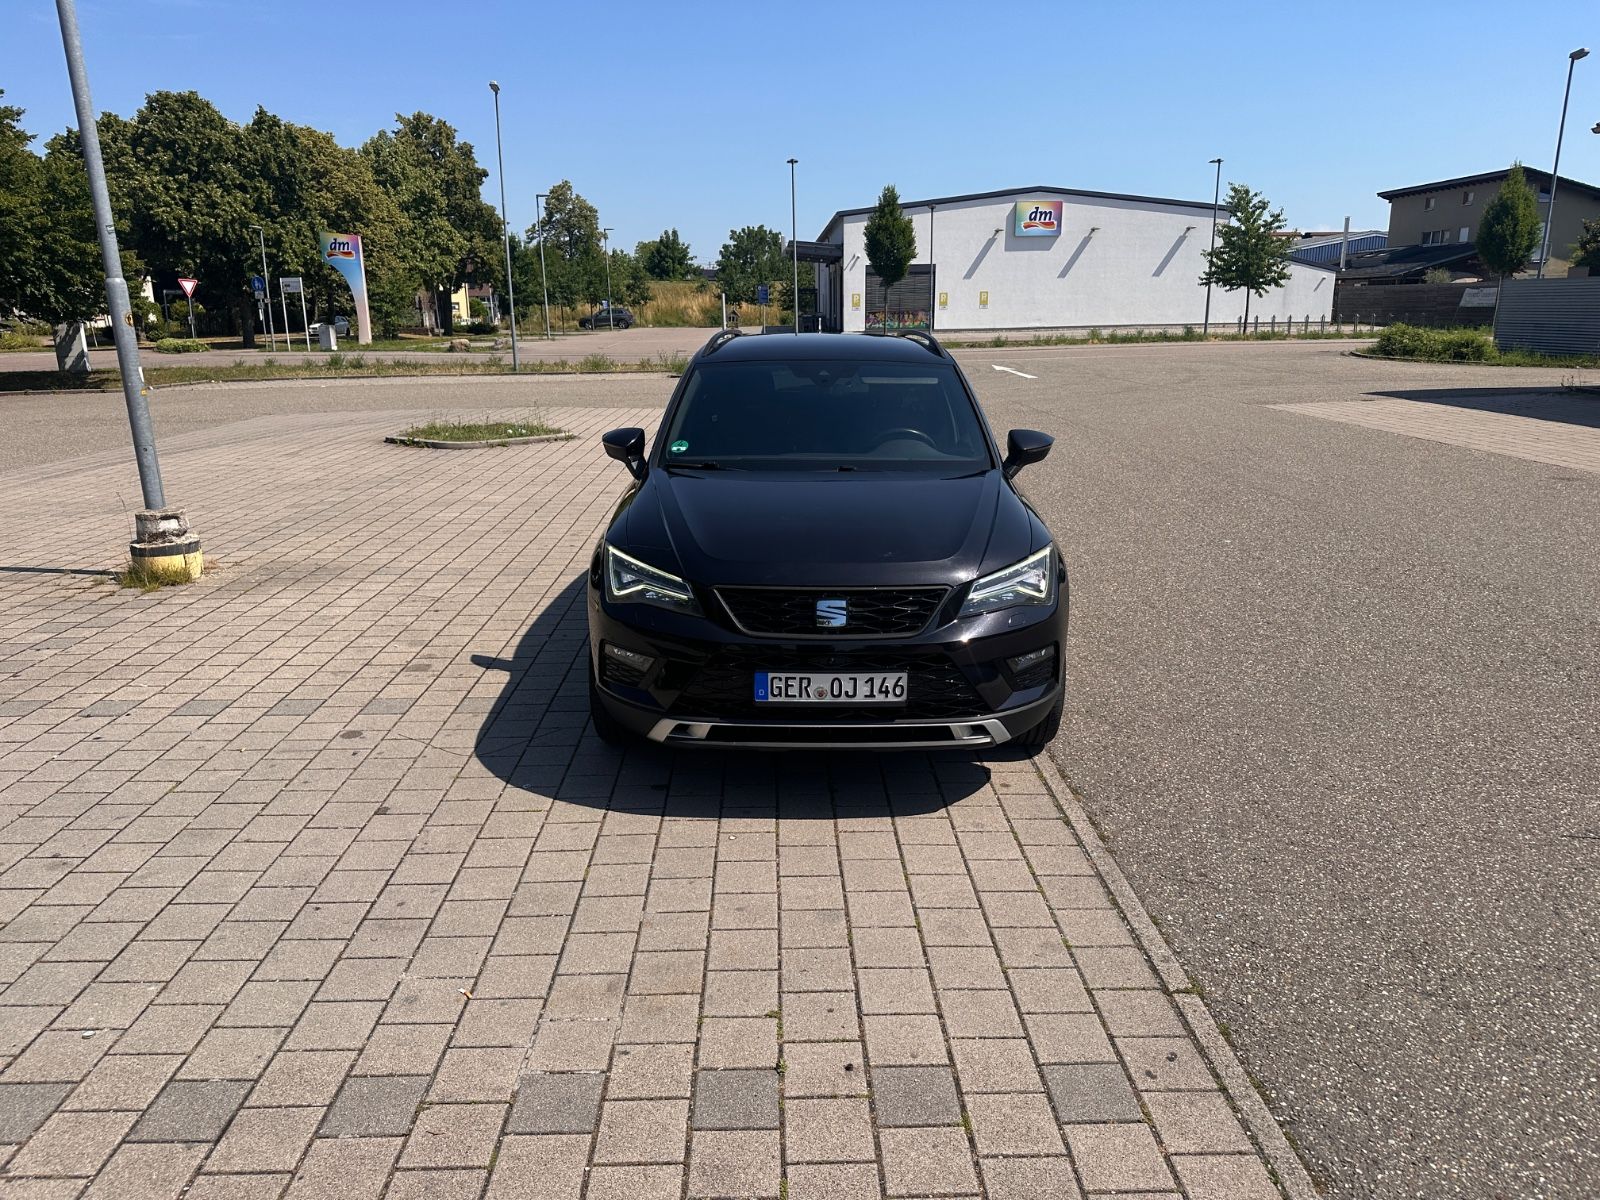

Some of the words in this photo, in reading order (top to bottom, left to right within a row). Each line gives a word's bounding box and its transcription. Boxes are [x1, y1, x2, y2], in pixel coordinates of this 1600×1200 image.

[1029, 206, 1053, 221] dm
[329, 238, 350, 250] dm
[770, 676, 812, 698] GER
[830, 677, 858, 698] OJ
[864, 677, 905, 698] 146
